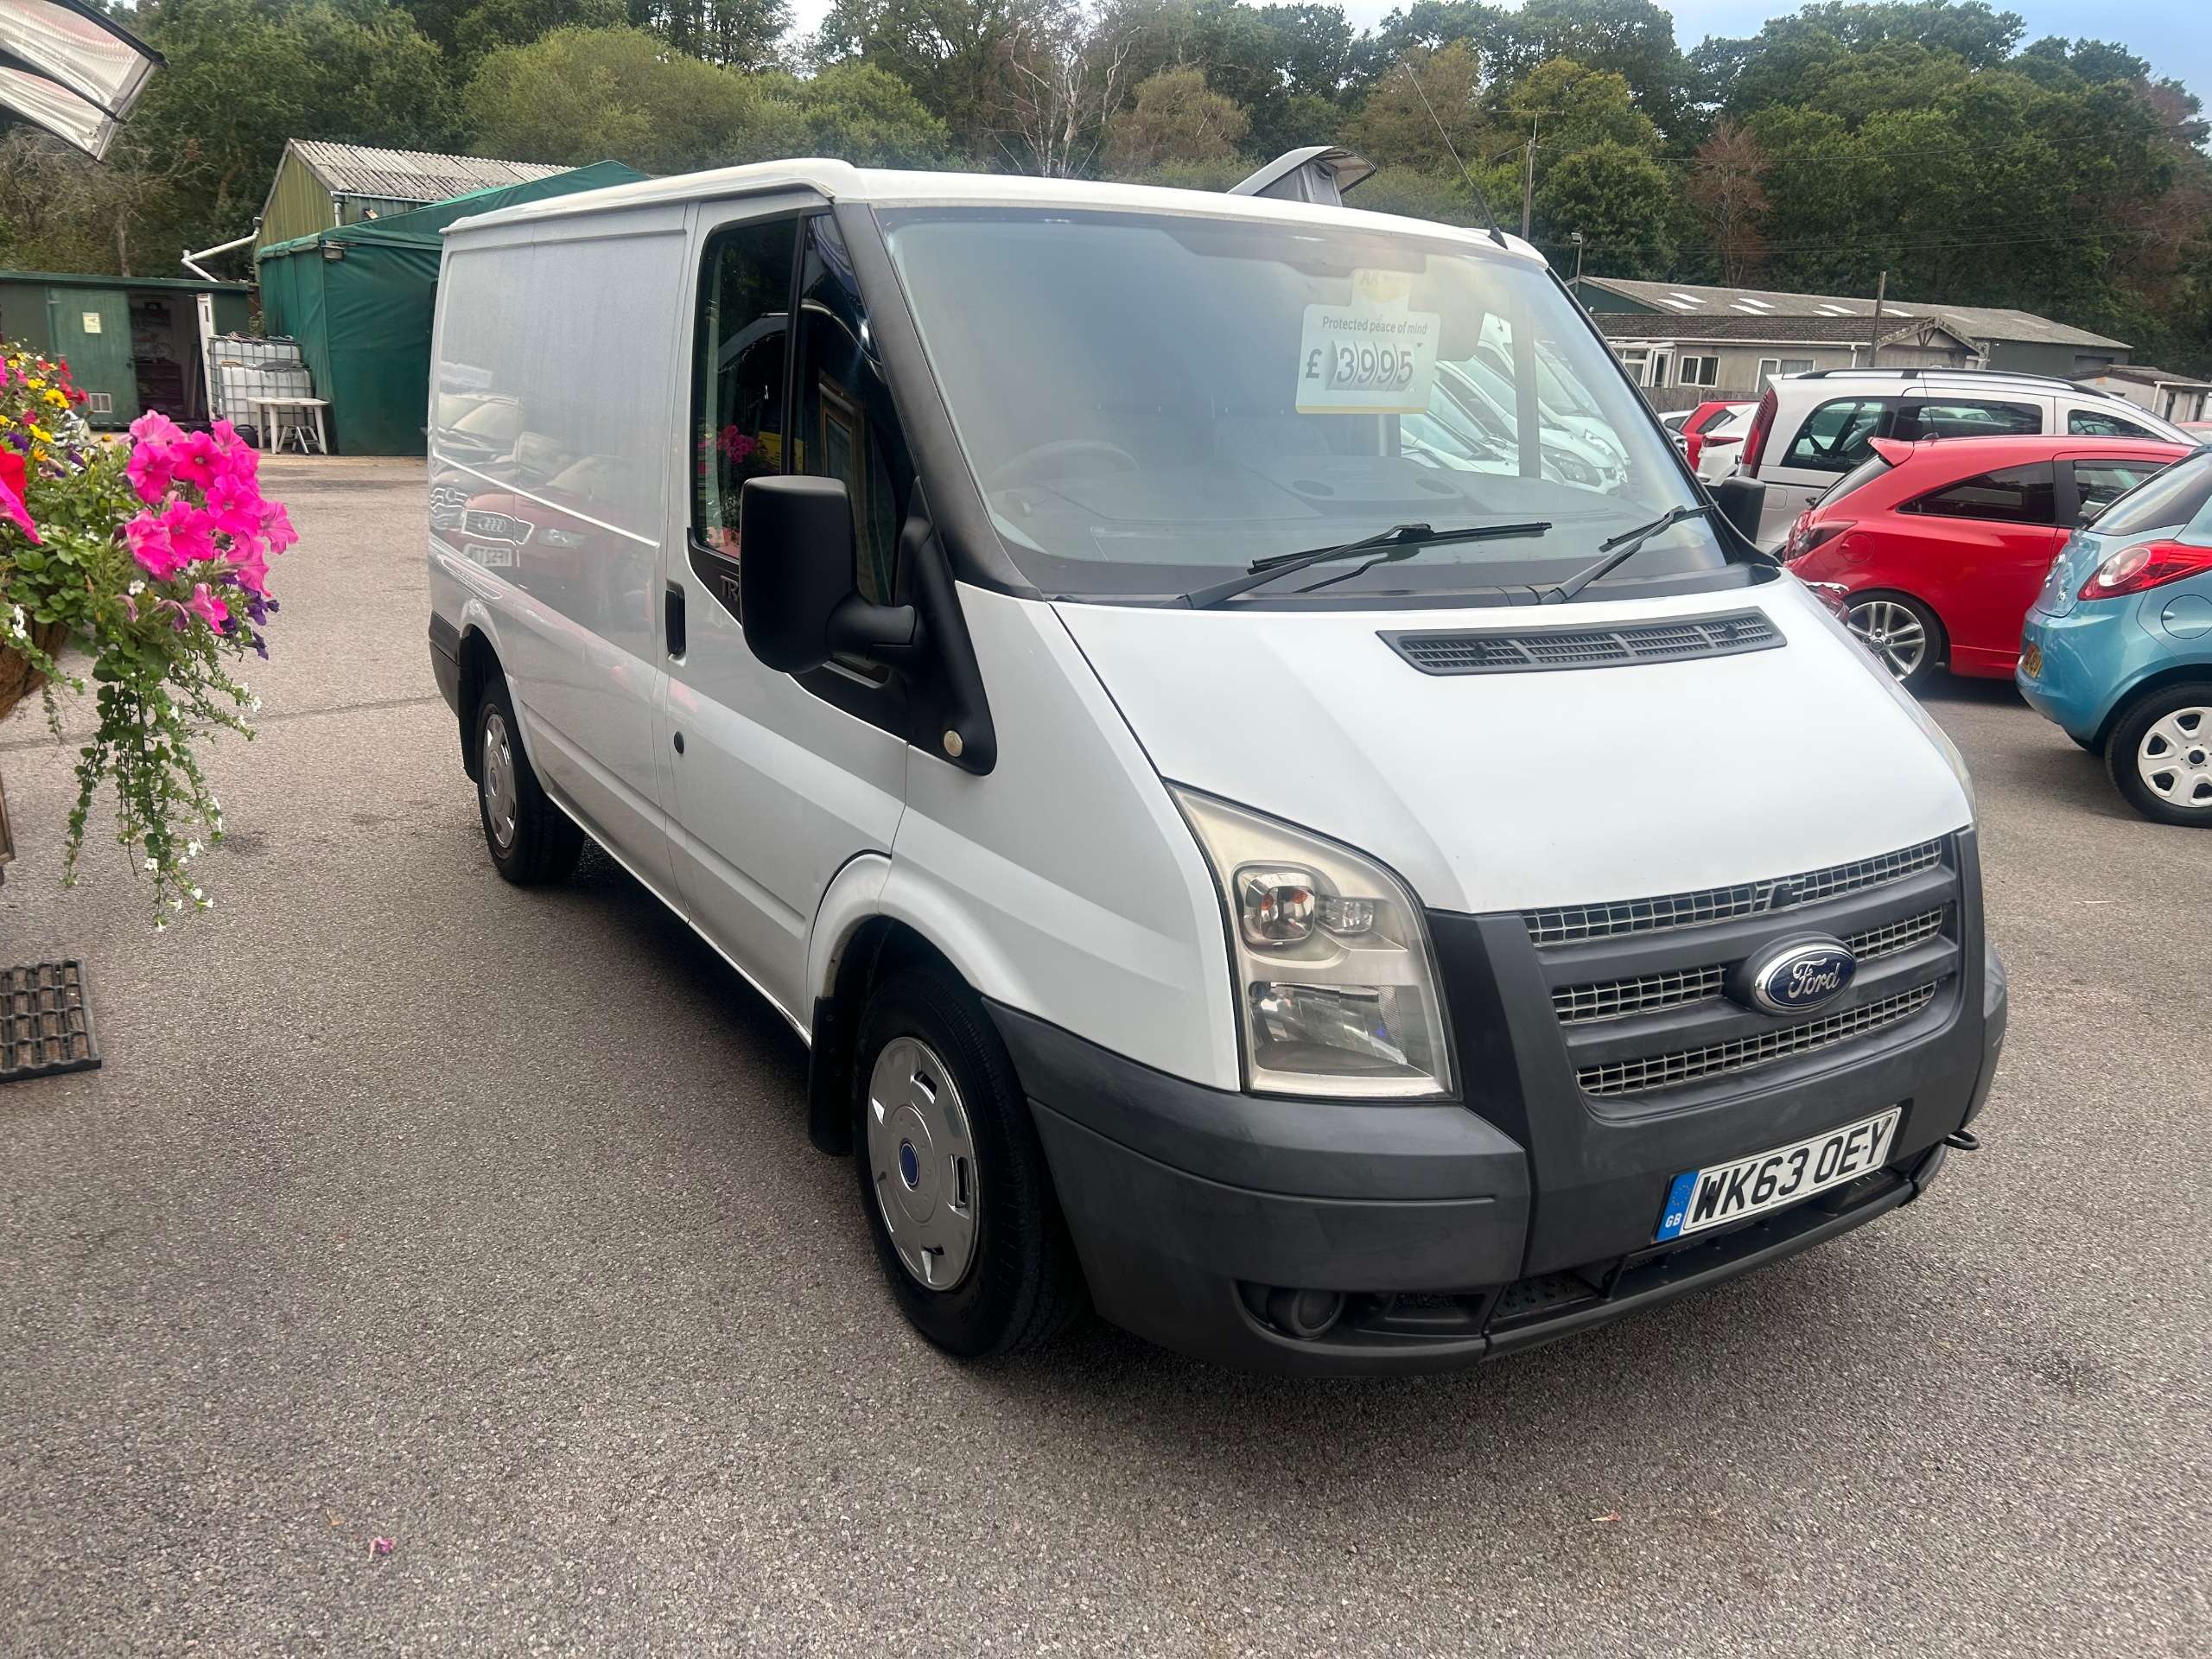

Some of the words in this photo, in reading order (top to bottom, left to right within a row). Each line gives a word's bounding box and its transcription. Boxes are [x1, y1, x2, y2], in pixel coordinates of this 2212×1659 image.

[1322, 315, 1369, 331] Protected
[1370, 321, 1395, 334] peace
[1397, 321, 1408, 334] of
[1407, 323, 1427, 335] mind
[1337, 346, 1414, 385] 3995
[1787, 957, 1841, 999] Ford
[1691, 1147, 1810, 1224] WK63
[1813, 1116, 1893, 1184] OEY
[1664, 1212, 1682, 1228] GB
